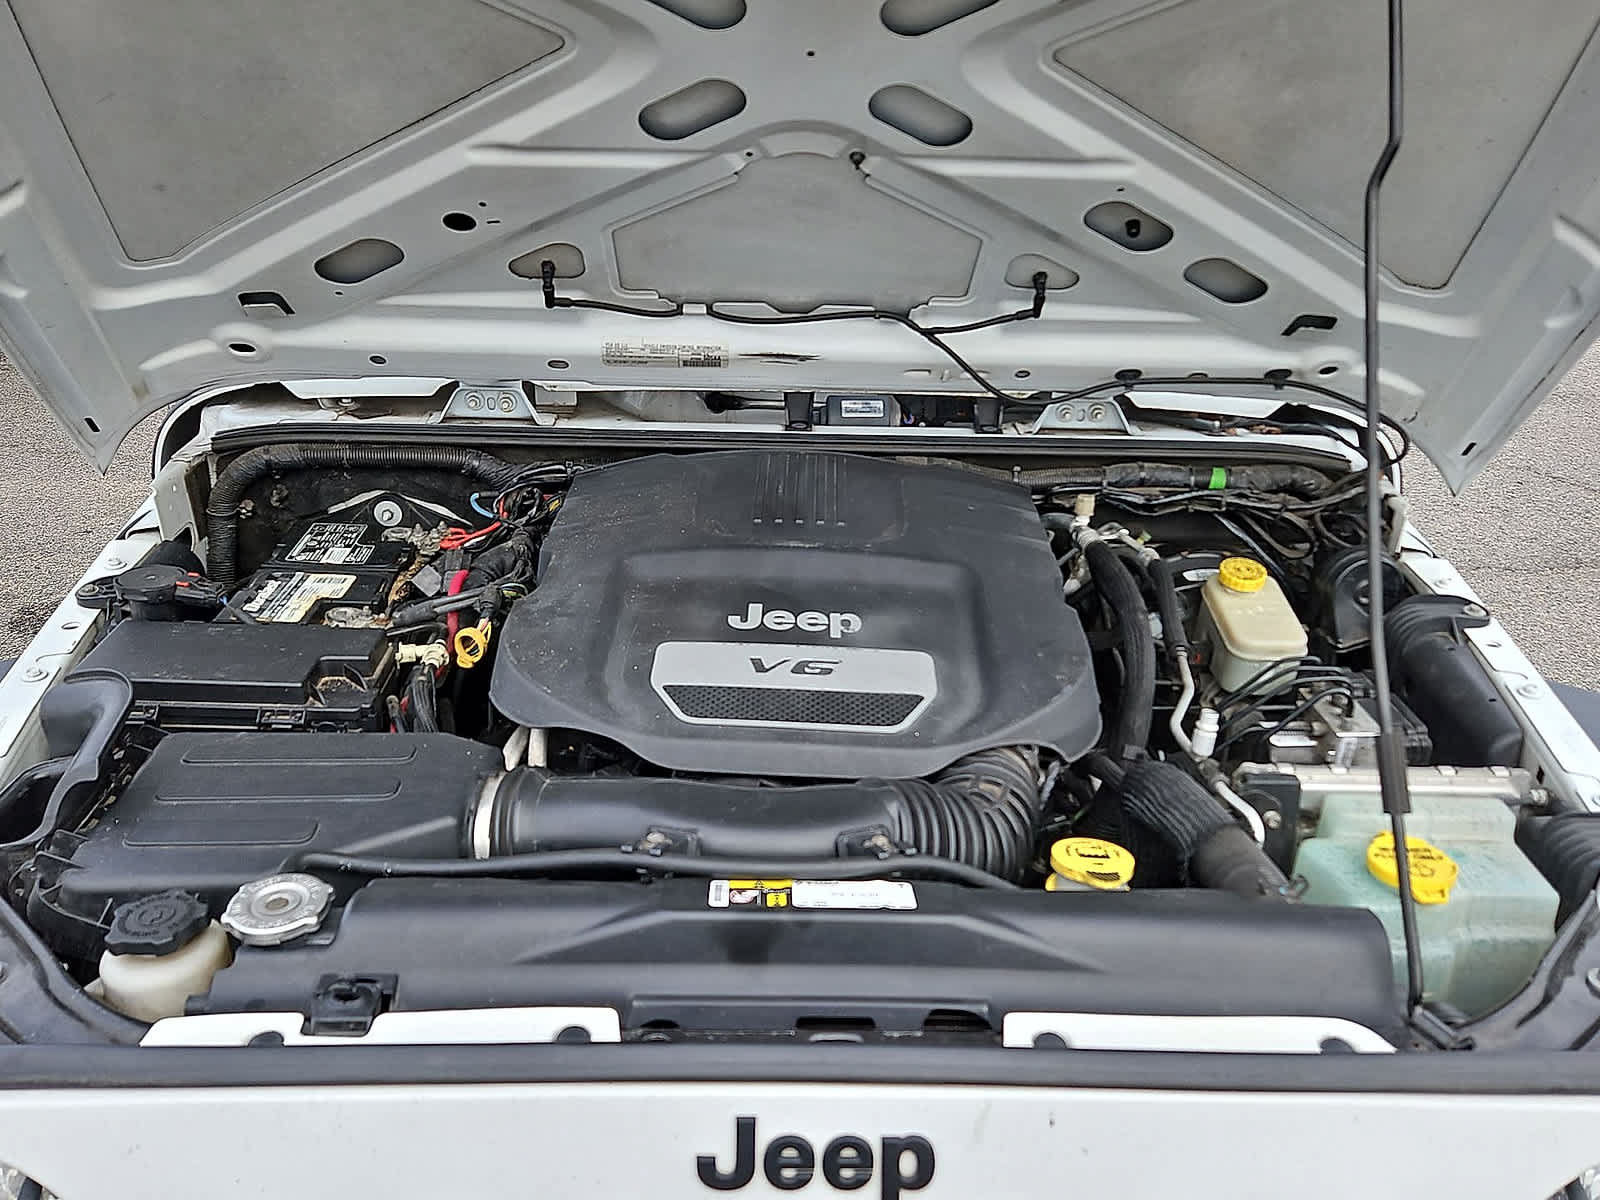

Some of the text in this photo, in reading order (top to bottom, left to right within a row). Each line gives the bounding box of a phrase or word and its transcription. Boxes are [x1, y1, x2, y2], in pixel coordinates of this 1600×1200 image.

[727, 602, 862, 638] Jeep
[749, 657, 842, 676] V6
[696, 1116, 936, 1200] Jeep
